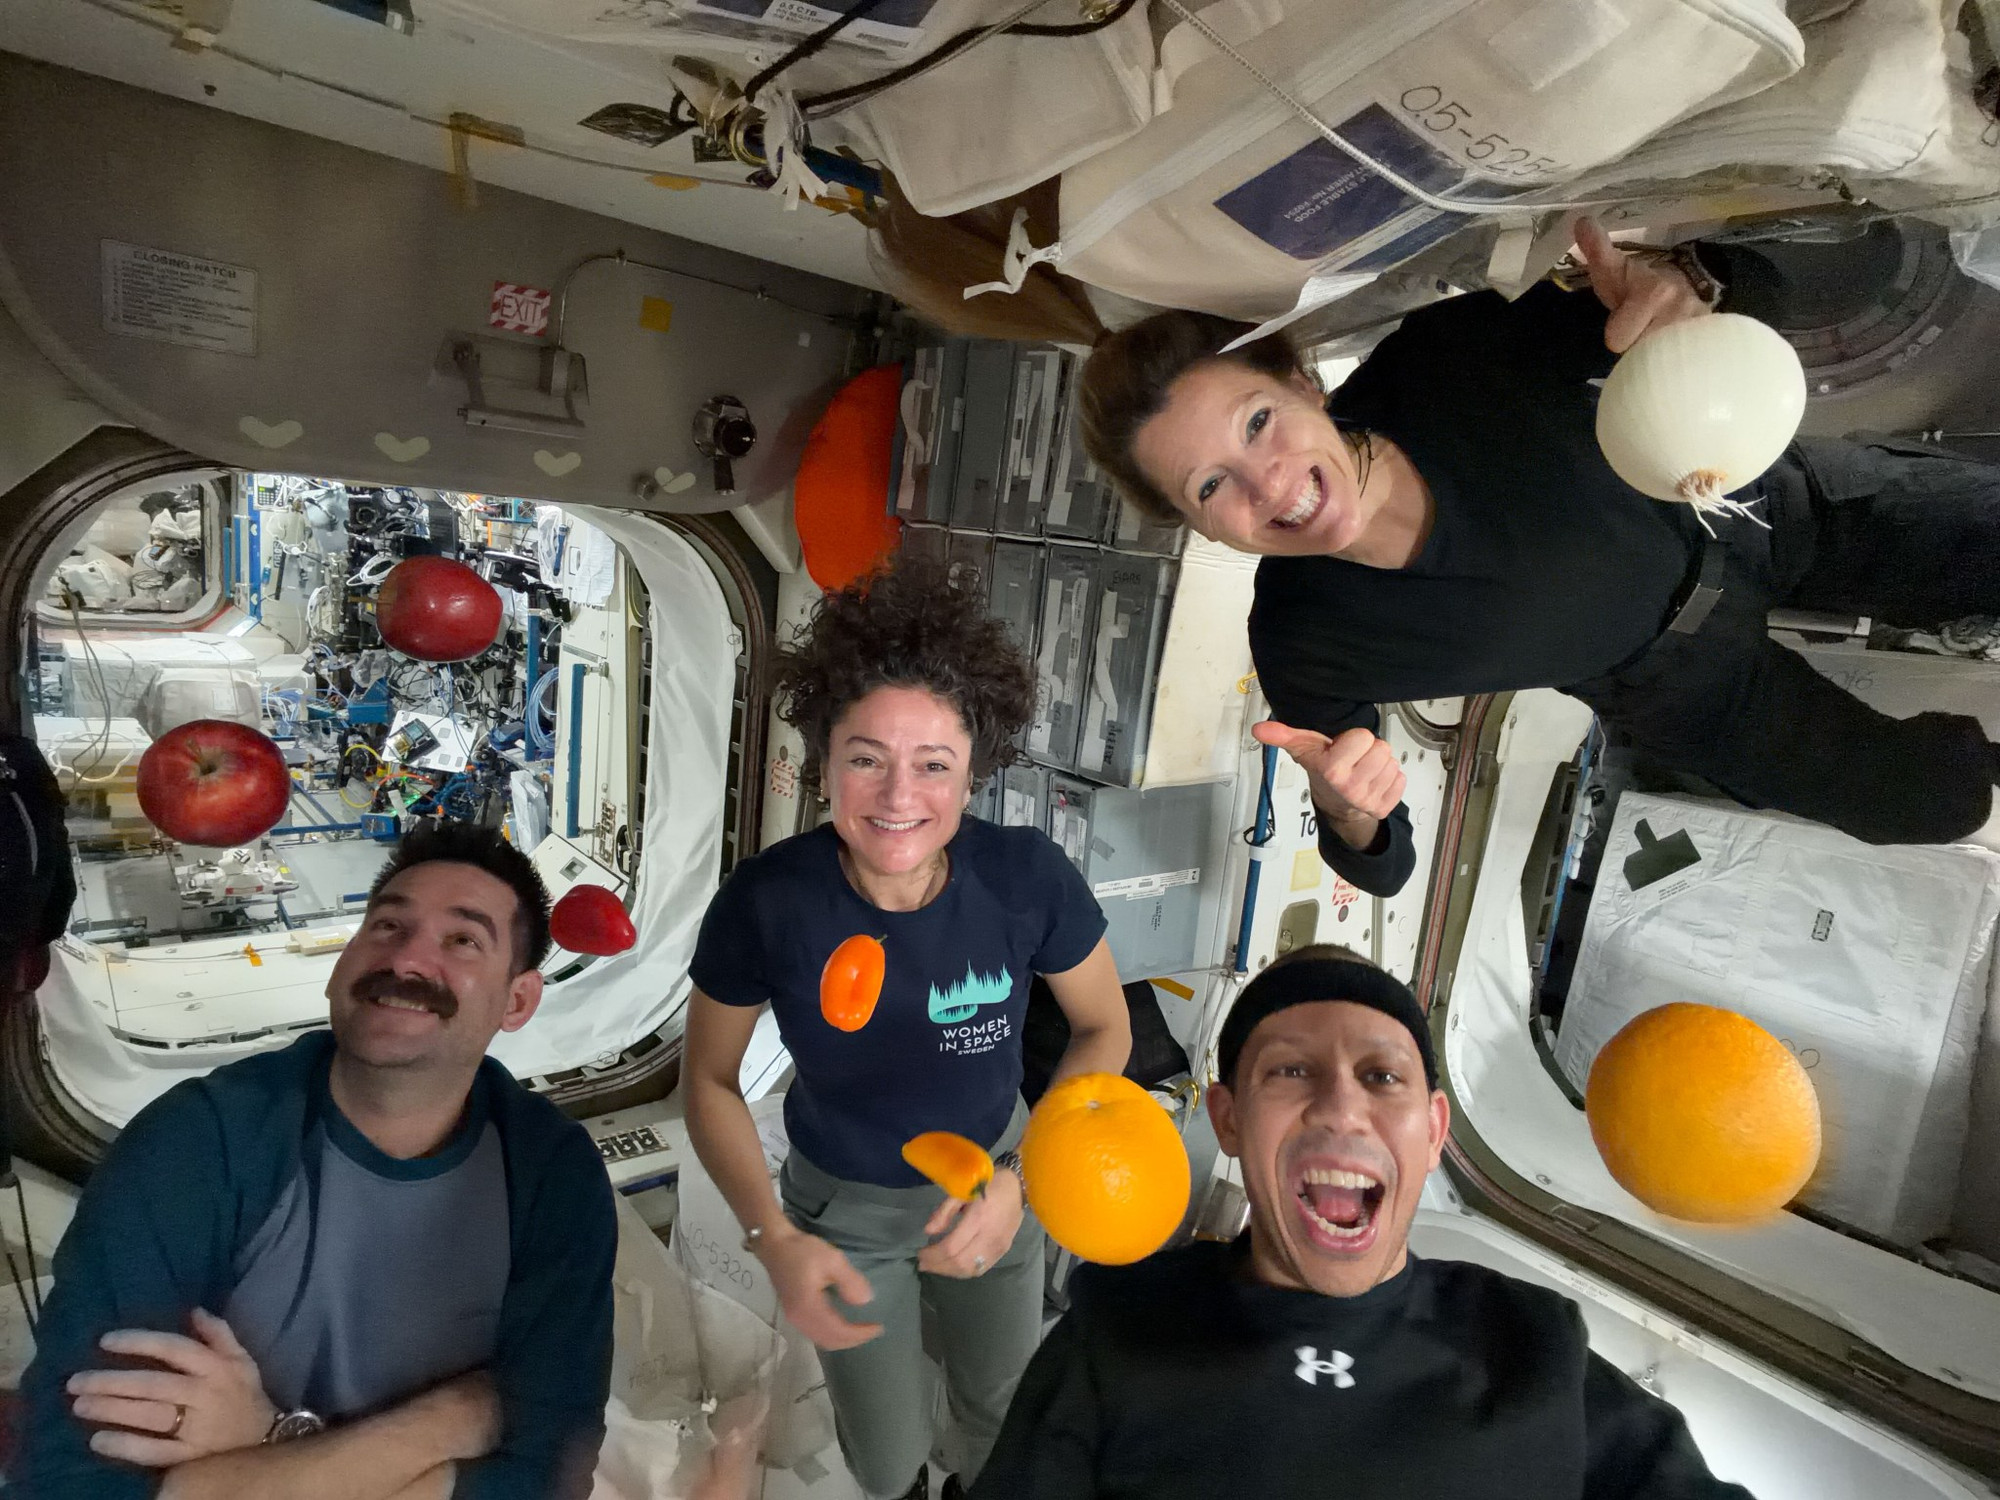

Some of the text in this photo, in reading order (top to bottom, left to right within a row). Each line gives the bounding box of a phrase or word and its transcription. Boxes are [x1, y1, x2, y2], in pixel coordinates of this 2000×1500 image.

[1293, 203, 1320, 224] FOOD
[194, 263, 237, 279] HATCH
[501, 294, 541, 324] EXIT
[939, 1024, 1012, 1052] IN SPACE
[942, 1014, 1008, 1040] WOMEN
[957, 1044, 995, 1056] SWEDEN
